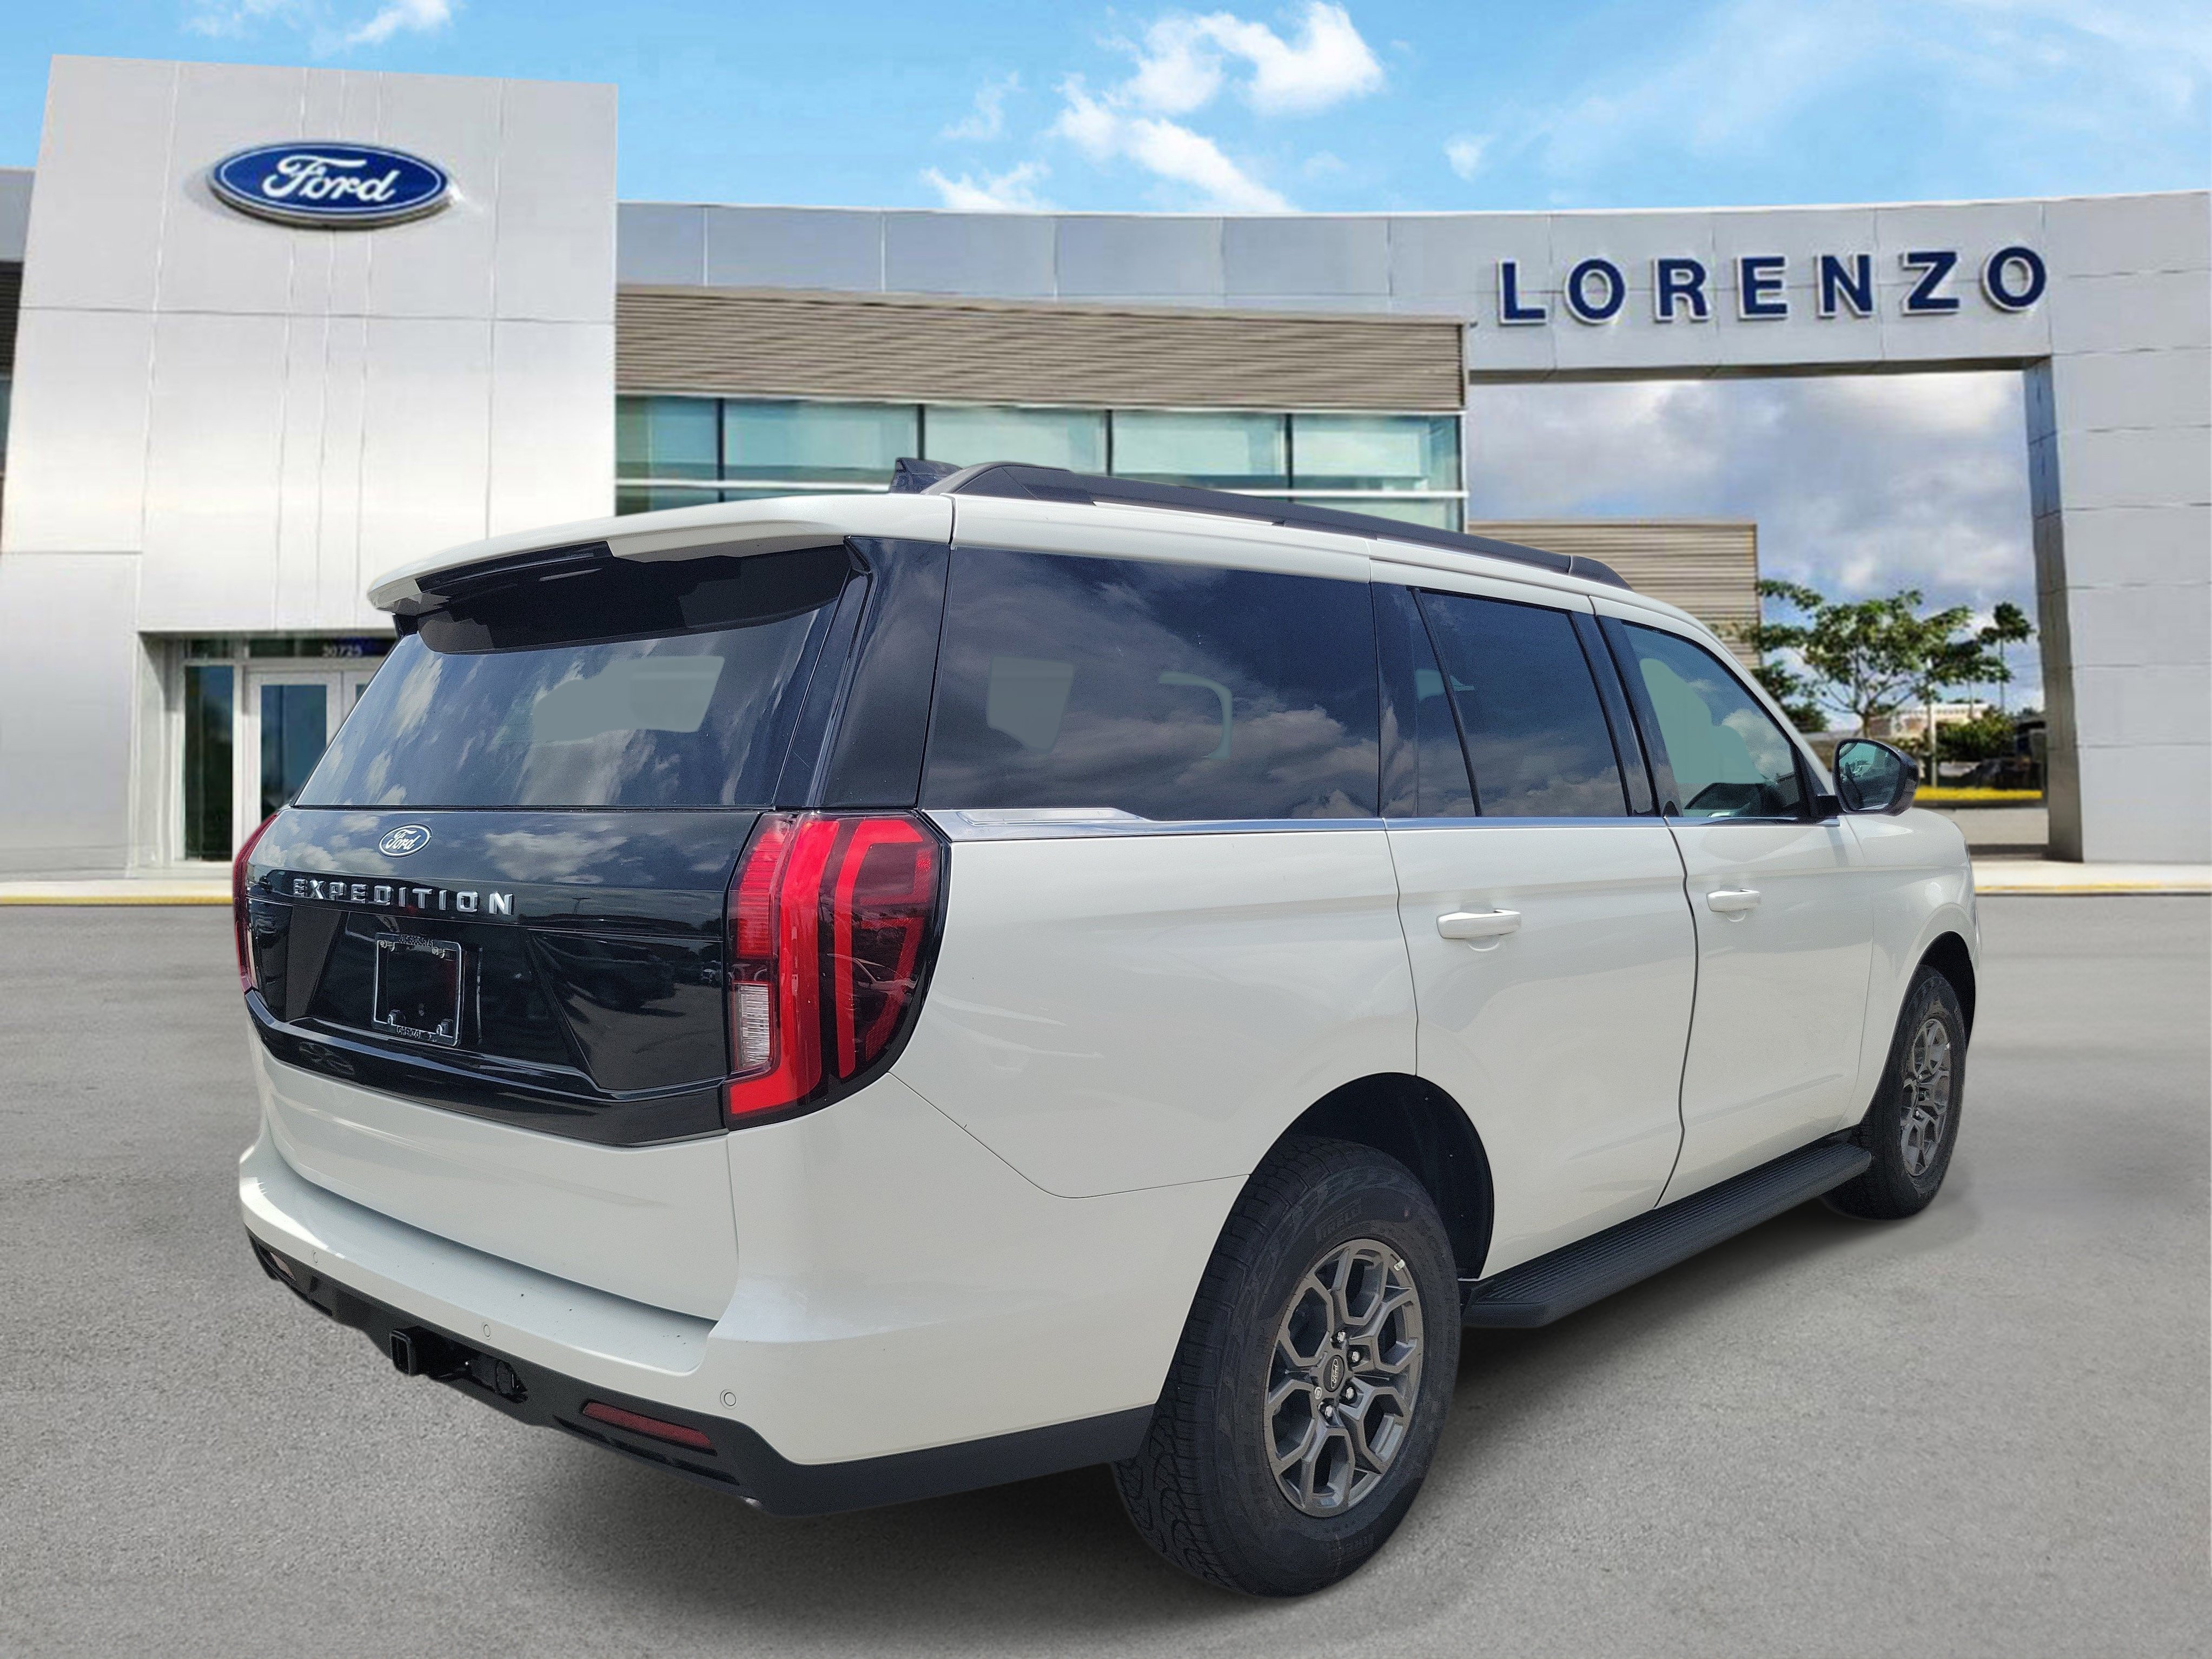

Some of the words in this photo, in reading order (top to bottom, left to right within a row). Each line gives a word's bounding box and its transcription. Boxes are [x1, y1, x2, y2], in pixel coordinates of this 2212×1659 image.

[262, 154, 401, 202] Ford
[1496, 246, 2048, 325] LORENZO
[385, 829, 422, 850] Ford
[293, 877, 514, 915] EXPEDITION
